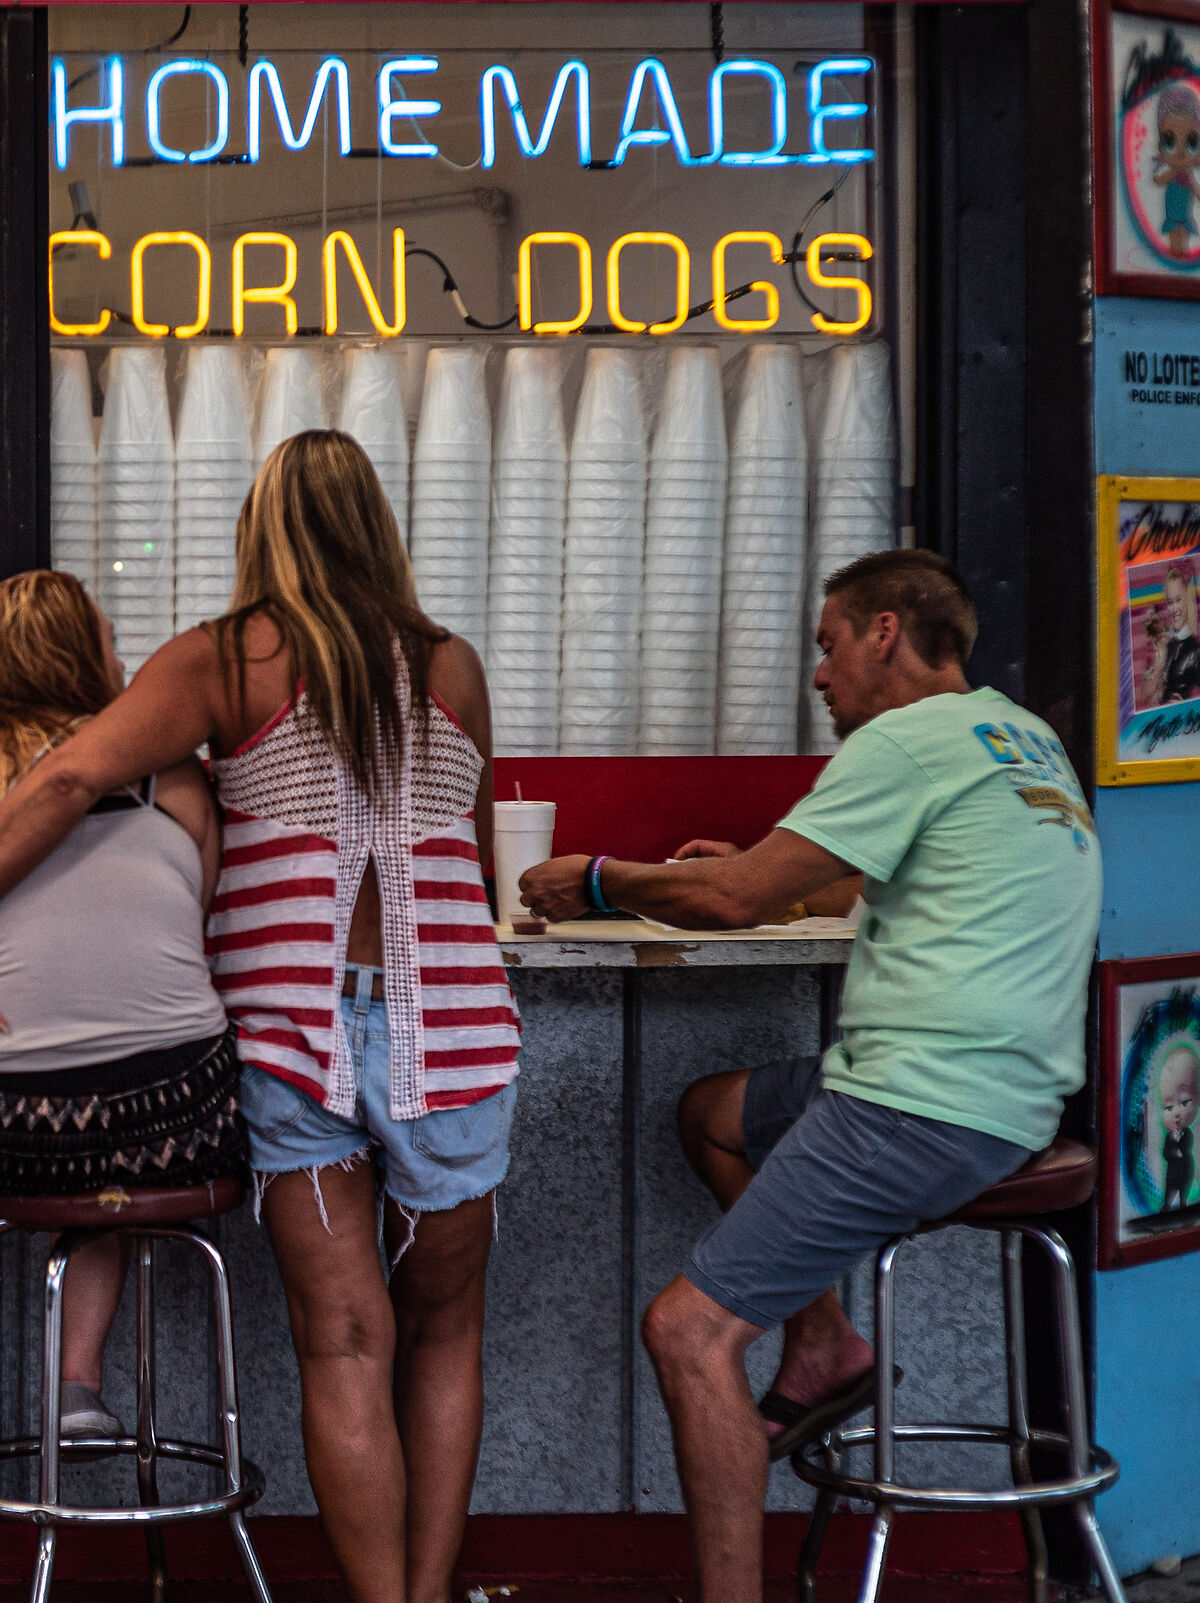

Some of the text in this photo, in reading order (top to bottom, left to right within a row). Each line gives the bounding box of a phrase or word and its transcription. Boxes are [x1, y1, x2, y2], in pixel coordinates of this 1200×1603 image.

[52, 56, 876, 169] HOME MADE
[48, 226, 874, 338] CORN DOGS
[1125, 351, 1200, 386] NO LOITE
[1132, 389, 1172, 404] POLICE
